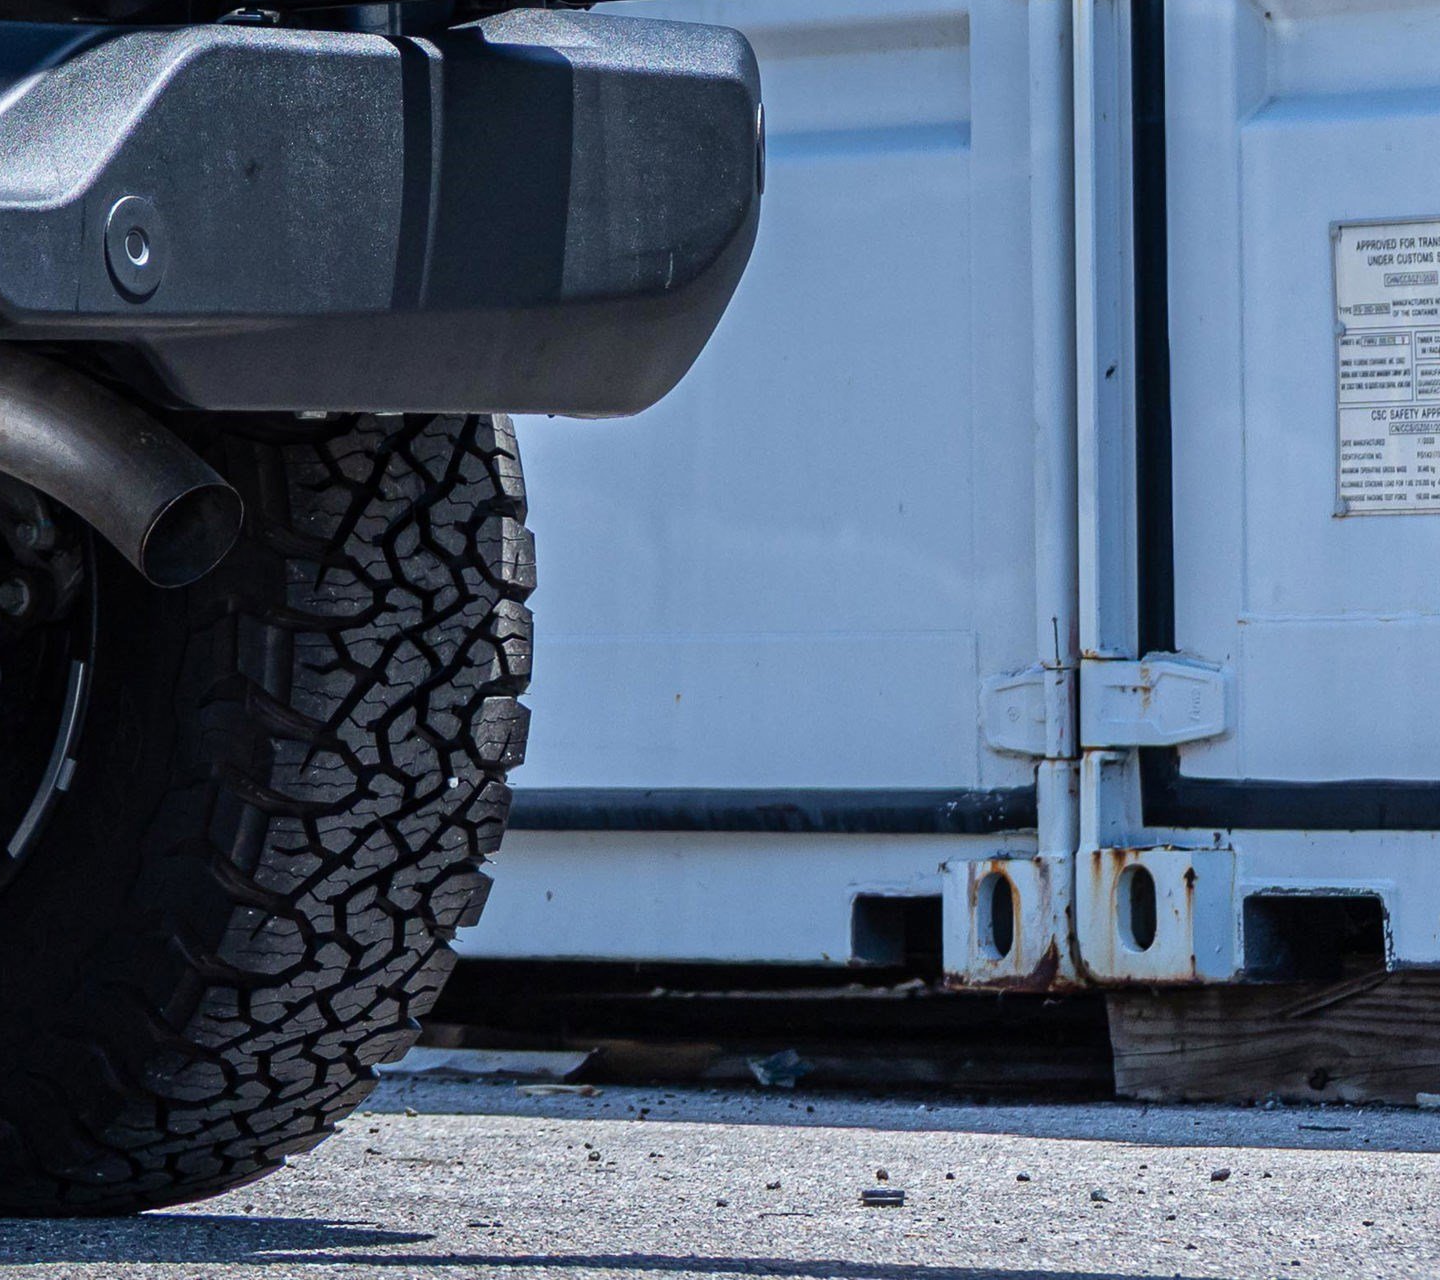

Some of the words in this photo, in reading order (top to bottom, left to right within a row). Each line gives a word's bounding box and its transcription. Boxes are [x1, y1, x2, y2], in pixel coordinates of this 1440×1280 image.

[1356, 238, 1396, 250] APPROVED
[1400, 237, 1415, 248] FOR
[1368, 254, 1393, 266] UNDER
[1397, 252, 1434, 264] CUSTOMS
[1371, 410, 1387, 421] CSC
[1390, 409, 1418, 420] SAFETY
